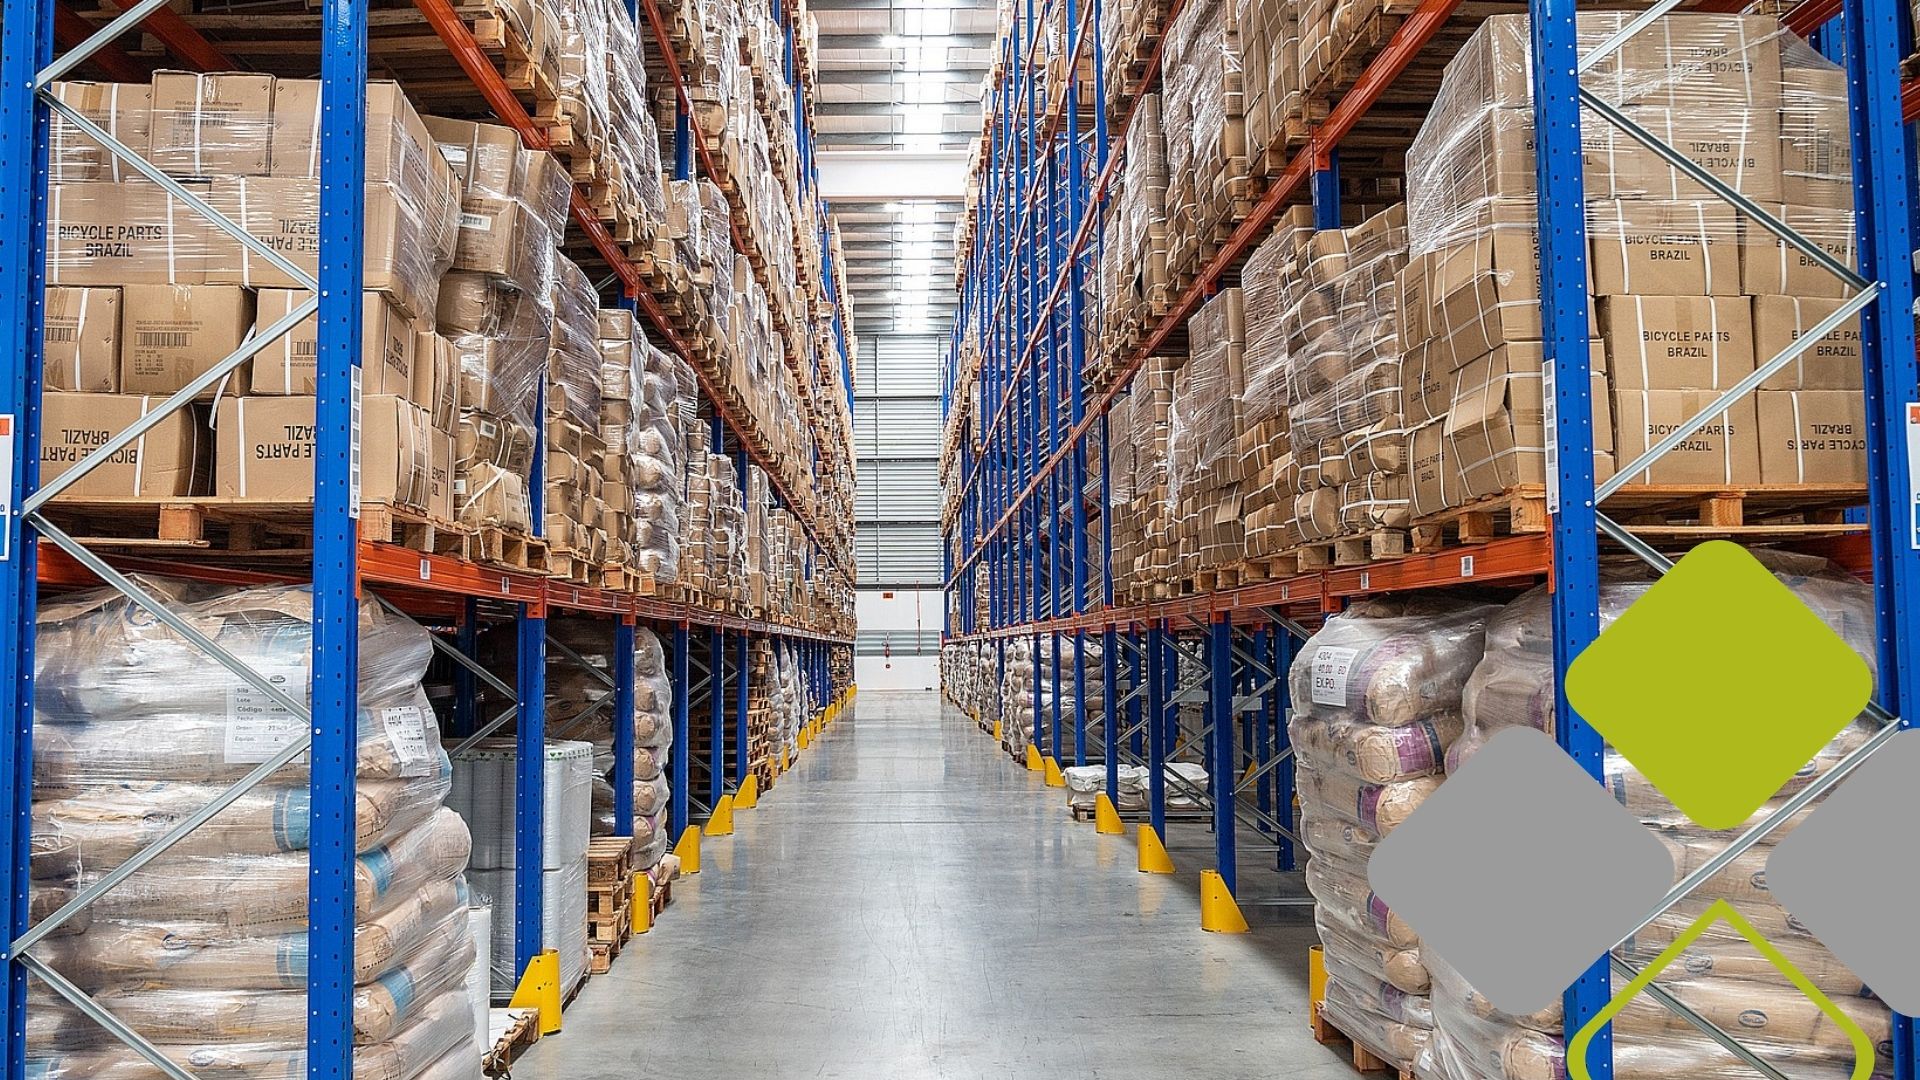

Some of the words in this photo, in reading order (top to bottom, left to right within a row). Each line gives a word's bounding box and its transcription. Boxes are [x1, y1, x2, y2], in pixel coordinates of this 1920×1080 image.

[1689, 142, 1730, 153] BRAZIL
[1706, 157, 1755, 168] BIYCLE
[279, 219, 319, 234] RAZIL
[59, 226, 115, 241] BICYCLE
[117, 226, 162, 240] PARTS
[1625, 234, 1674, 245] BICYCLE
[86, 243, 134, 257] BRAZIL
[1650, 249, 1691, 260] BRAZIL
[1827, 243, 1859, 256] PART
[1642, 330, 1691, 342] BICYCLE
[1667, 346, 1708, 358] BRAZIL
[1816, 346, 1857, 357] BRAZIL
[283, 425, 317, 440] AZIL
[1648, 424, 1696, 436] BICY
[1811, 424, 1852, 435] BRAZIL
[61, 429, 109, 445] BRAZIL
[1787, 440, 1825, 450] PARS
[1828, 439, 1866, 450] CYCLE
[40, 446, 76, 462] PART
[81, 447, 139, 464] BICYE
[255, 443, 299, 459] PARTS
[237, 706, 263, 714] Código
